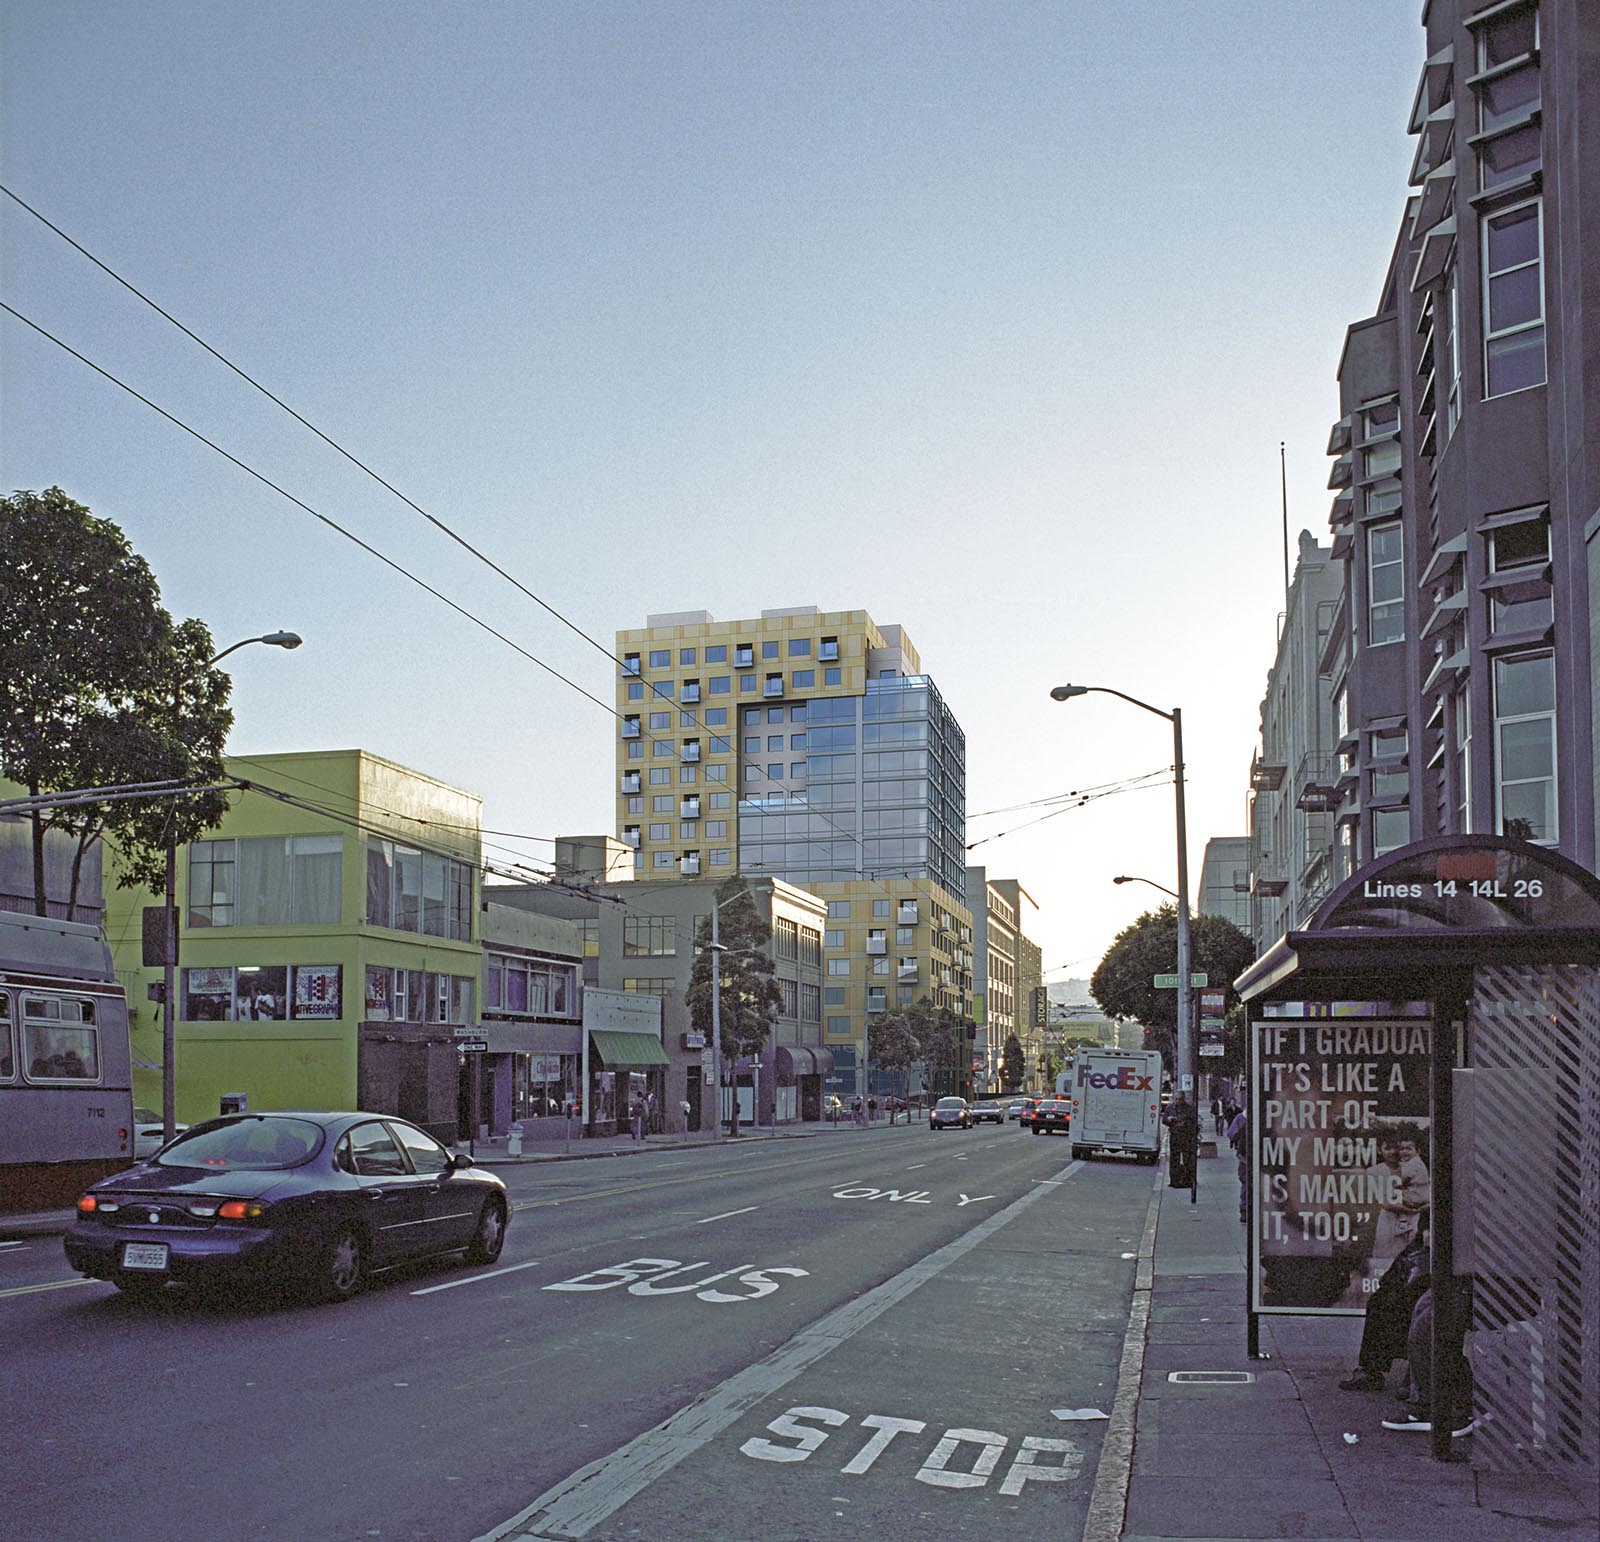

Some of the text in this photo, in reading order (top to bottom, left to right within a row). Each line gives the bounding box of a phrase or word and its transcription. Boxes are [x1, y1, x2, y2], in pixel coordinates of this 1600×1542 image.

[1364, 880, 1543, 897] Lines 14 14L 26
[1037, 988, 1046, 1023] STORAGE
[1264, 1028, 1289, 1055] IF
[1300, 1028, 1305, 1055] I
[1077, 1064, 1154, 1092] FedEx
[1264, 1063, 1405, 1092] IT'S LIKE A
[88, 1107, 104, 1118] 7112
[1266, 1100, 1378, 1130] PART OF
[1263, 1137, 1377, 1167] MY MOM
[833, 1187, 996, 1206] ONLY
[1263, 1174, 1403, 1205] IS MAKING
[1263, 1211, 1289, 1245] IT,
[541, 1257, 809, 1303] BUS
[740, 1406, 1084, 1496] STOP
